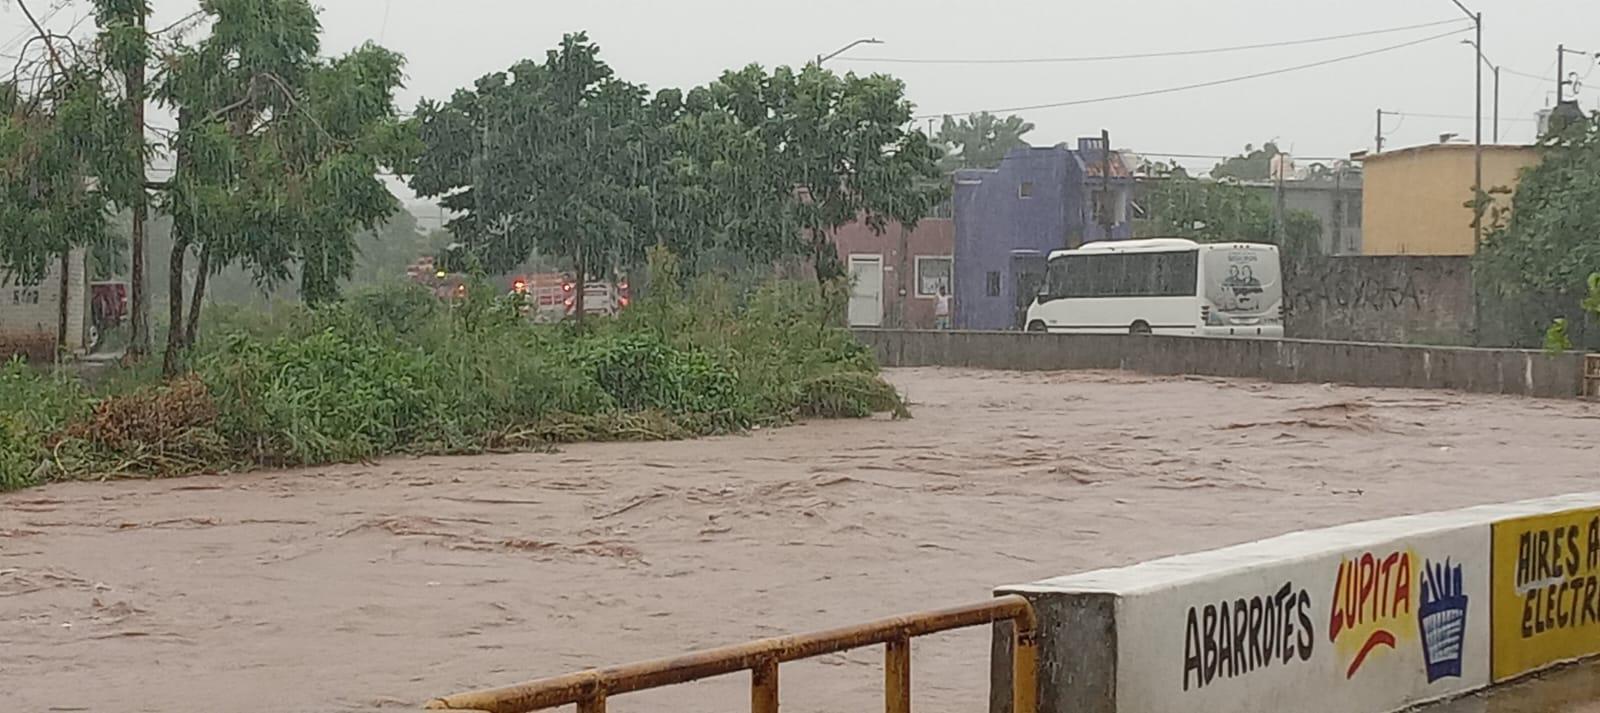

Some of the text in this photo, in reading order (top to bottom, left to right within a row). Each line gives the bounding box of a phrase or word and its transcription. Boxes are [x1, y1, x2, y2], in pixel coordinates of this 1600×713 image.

[1517, 525, 1580, 587] AIRES
[1183, 551, 1410, 691] ABARROTES LUPITA
